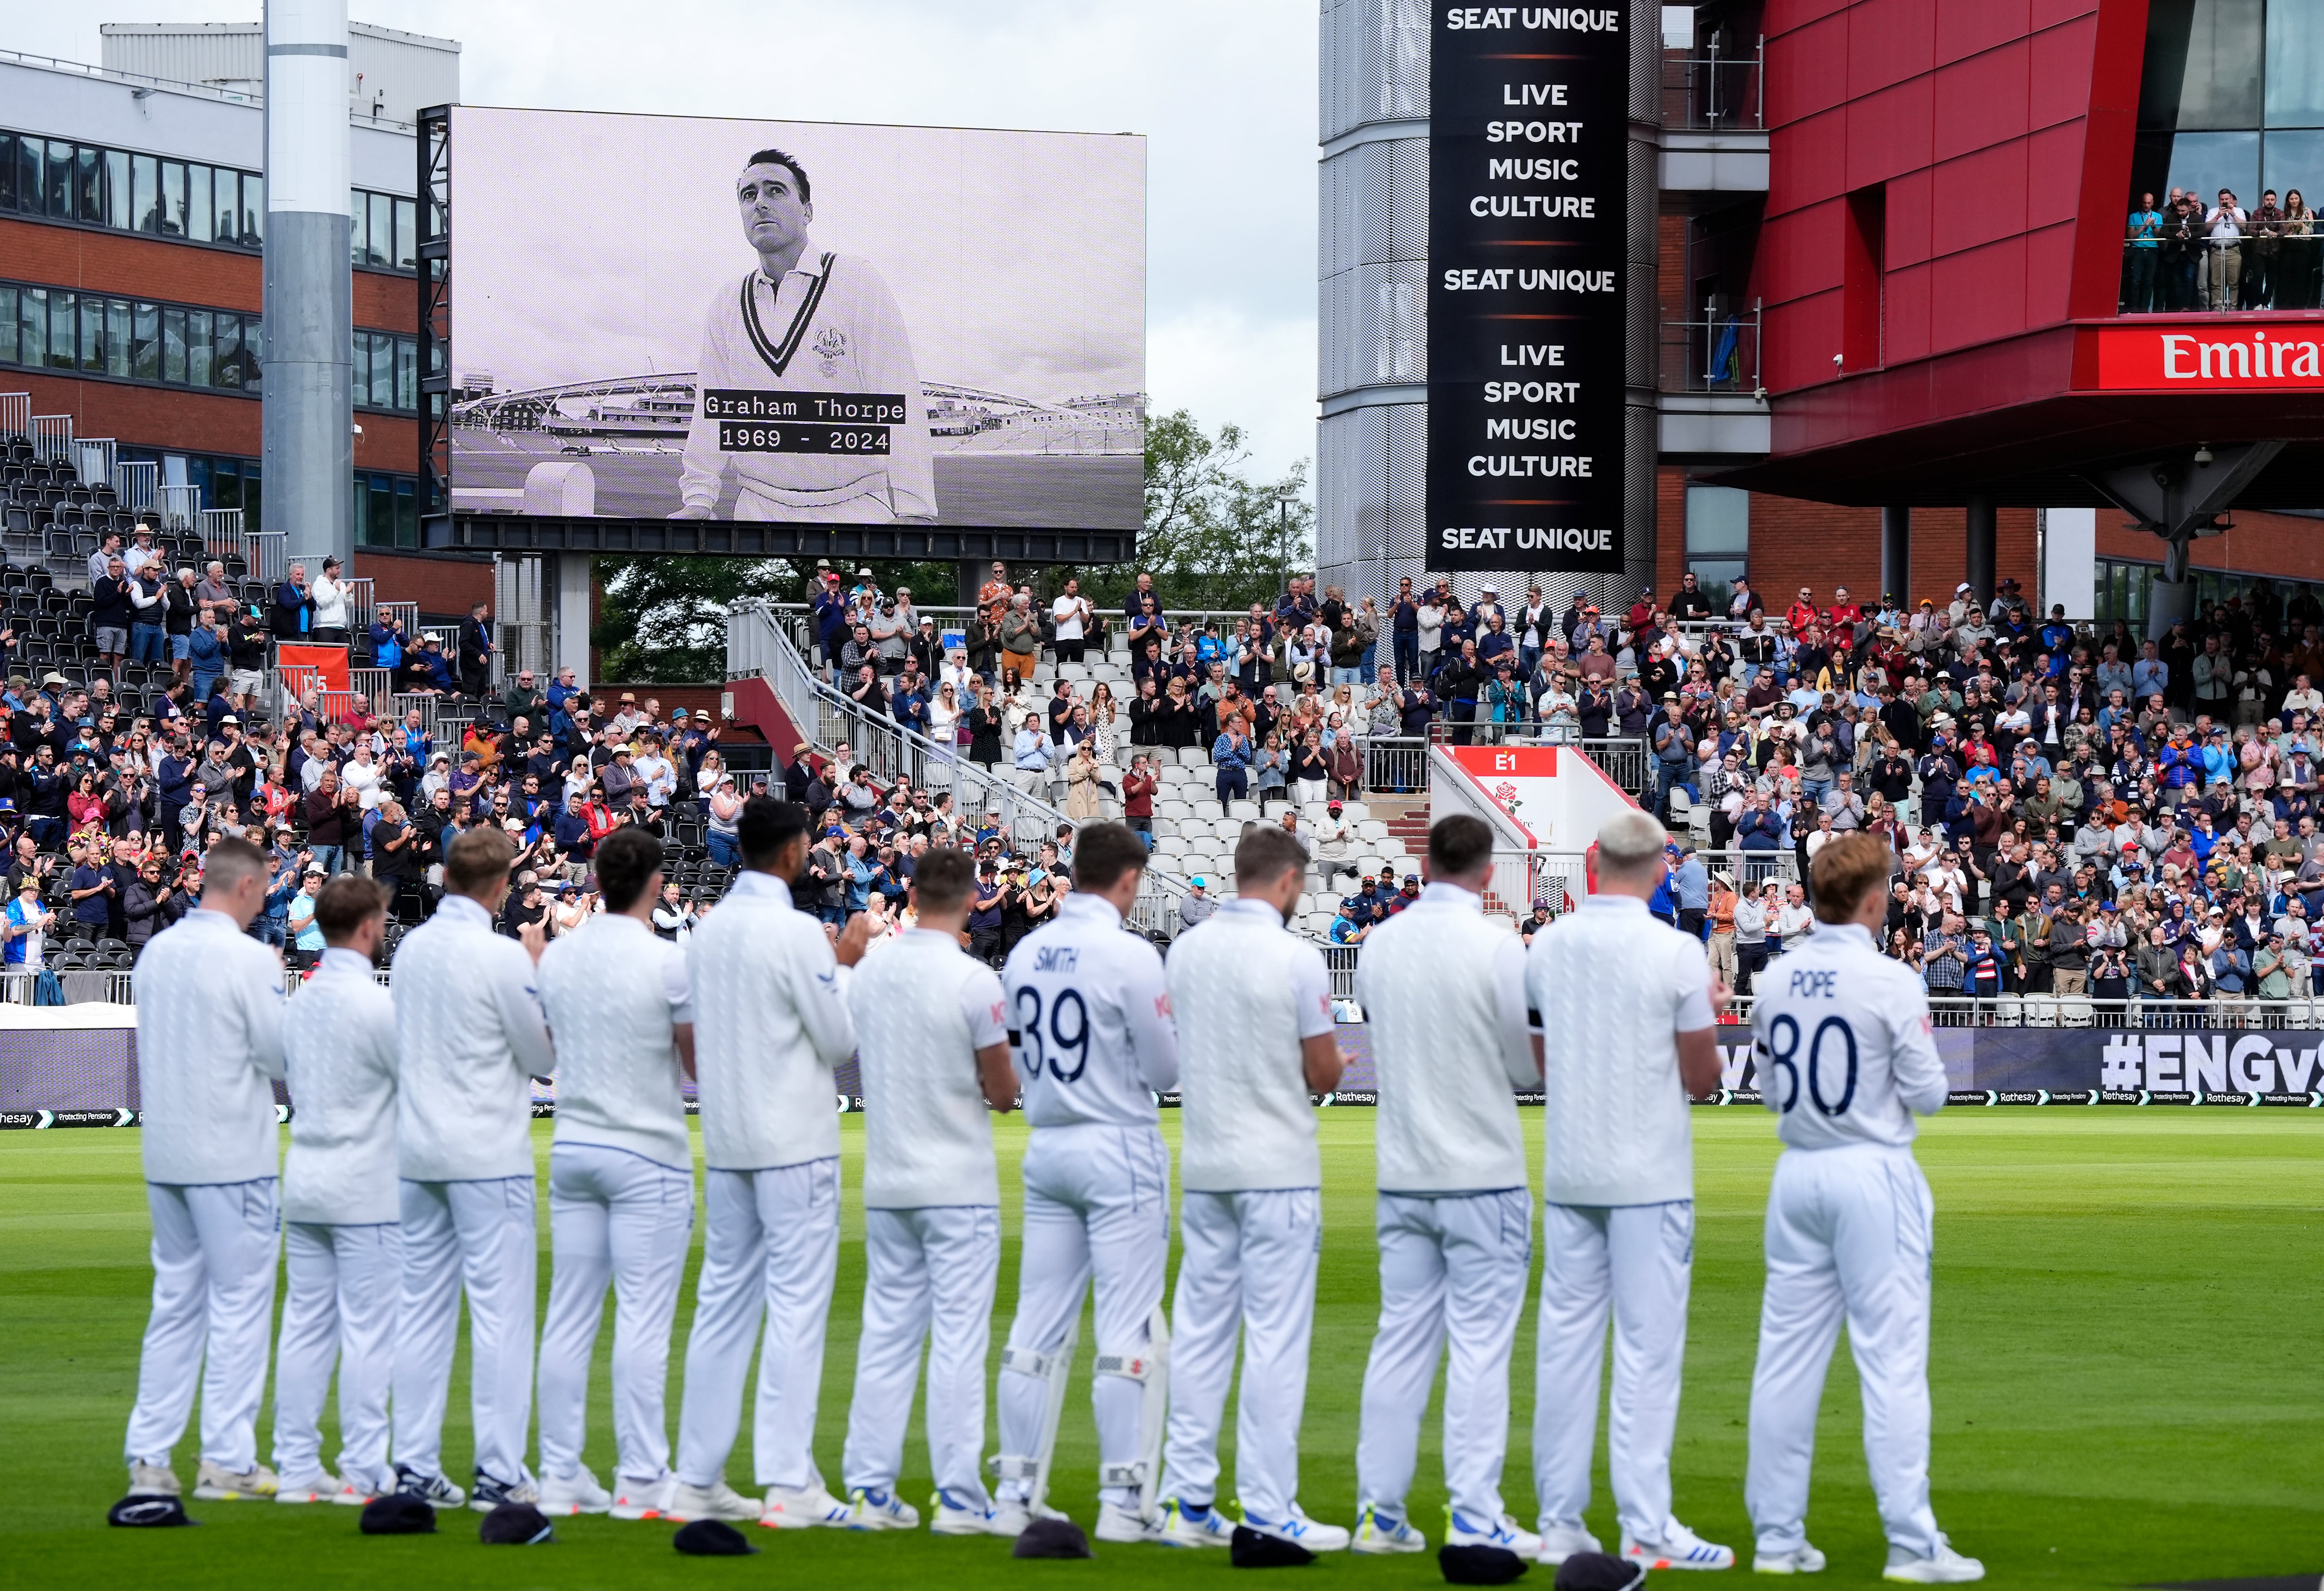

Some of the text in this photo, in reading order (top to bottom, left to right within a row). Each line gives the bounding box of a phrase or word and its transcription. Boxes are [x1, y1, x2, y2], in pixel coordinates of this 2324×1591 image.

[1447, 8, 1618, 33] SEAT UNIQUE
[1504, 84, 1567, 105] LIVE
[1487, 121, 1583, 142] SPORT
[1490, 159, 1578, 180] MUSIC
[1470, 196, 1594, 218] CULTURE
[1444, 269, 1614, 293] SEAT UNIQUE
[1502, 345, 1564, 366] LIVE
[2161, 331, 2324, 378] Emira
[1484, 382, 1580, 403] SPORT
[705, 397, 904, 422] Graham Thorpe
[723, 429, 781, 446] 1969
[830, 432, 888, 449] 2024
[1487, 419, 1576, 440] MUSIC
[1468, 456, 1592, 477] CULTURE
[1442, 528, 1611, 552] SEAT UNIQUE
[303, 675, 327, 692] D5
[1496, 754, 1516, 770] E1
[1034, 946, 1080, 973] SMITH
[1789, 970, 1837, 997] POPE
[1017, 986, 1088, 1083] 39
[1770, 1014, 1857, 1116] 80
[2101, 1035, 2324, 1093] #ENGv
[1336, 1092, 1376, 1103] Rothesay
[2000, 1093, 2036, 1103] Rothesay
[2102, 1091, 2137, 1103] Rothesay
[2207, 1093, 2246, 1104] Rothesay
[59, 1113, 87, 1121] Protecting
